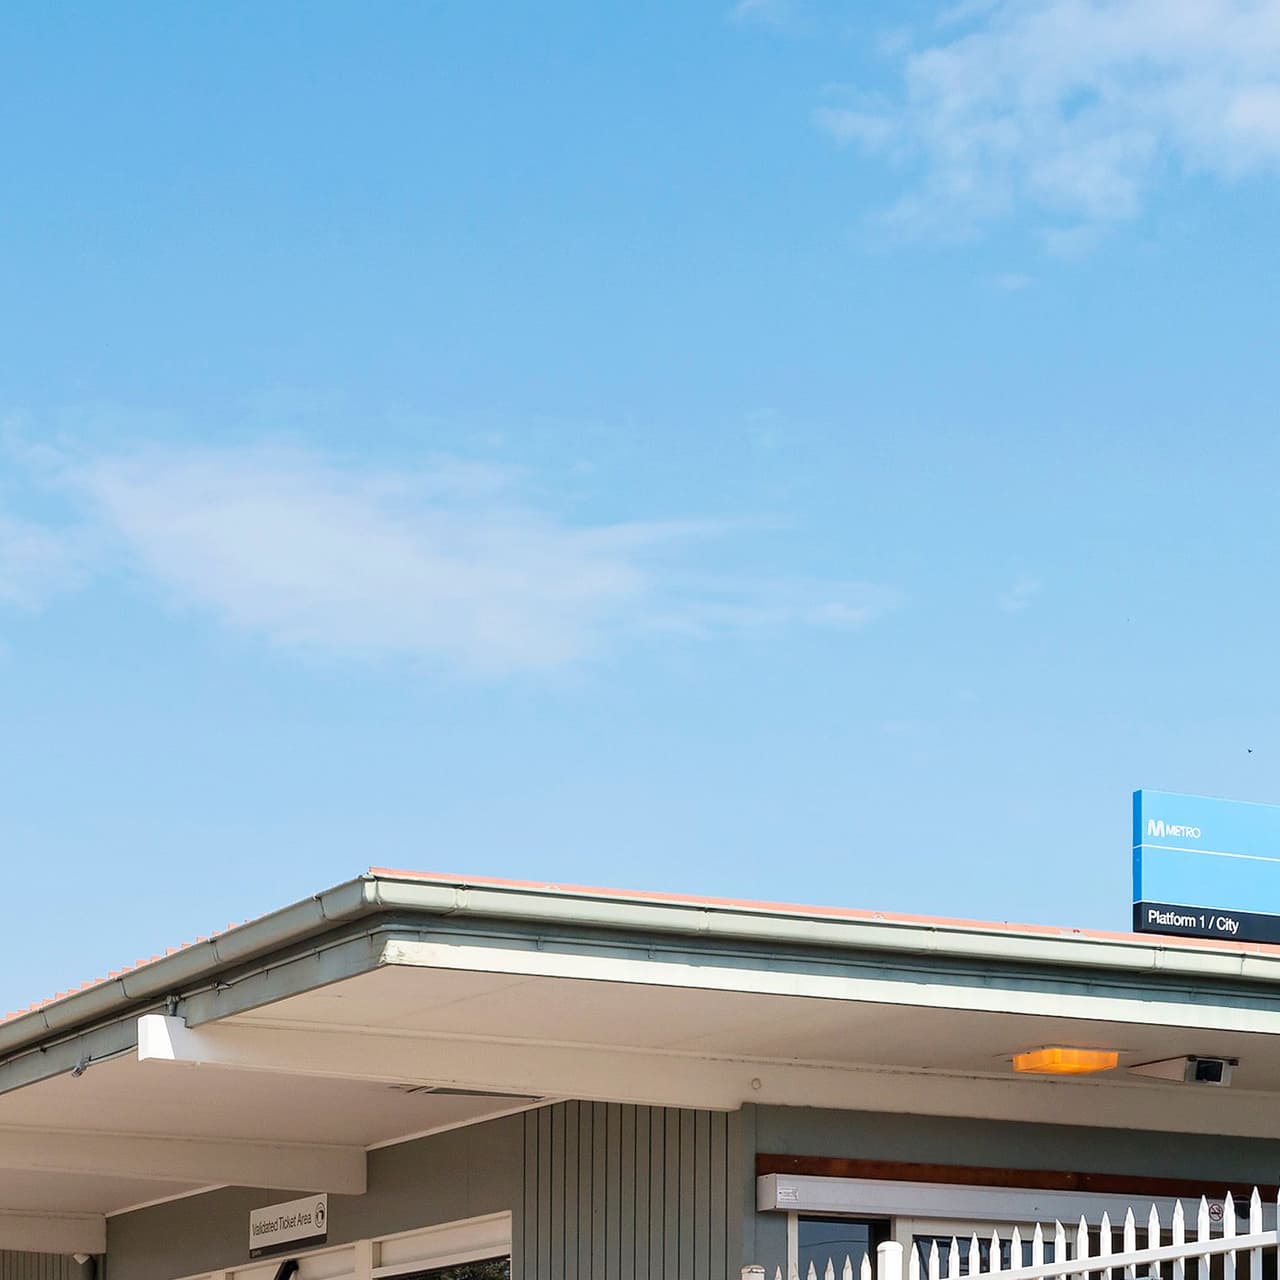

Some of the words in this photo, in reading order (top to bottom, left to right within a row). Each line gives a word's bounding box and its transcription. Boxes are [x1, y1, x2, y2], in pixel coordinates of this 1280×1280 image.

[1165, 824, 1201, 839] METRO
[1148, 909, 1197, 928] Platform
[1199, 915, 1205, 929] 1
[1216, 916, 1240, 935] City
[252, 1218, 279, 1236] Validated
[279, 1214, 297, 1231] Ticket
[297, 1212, 312, 1227] Area
